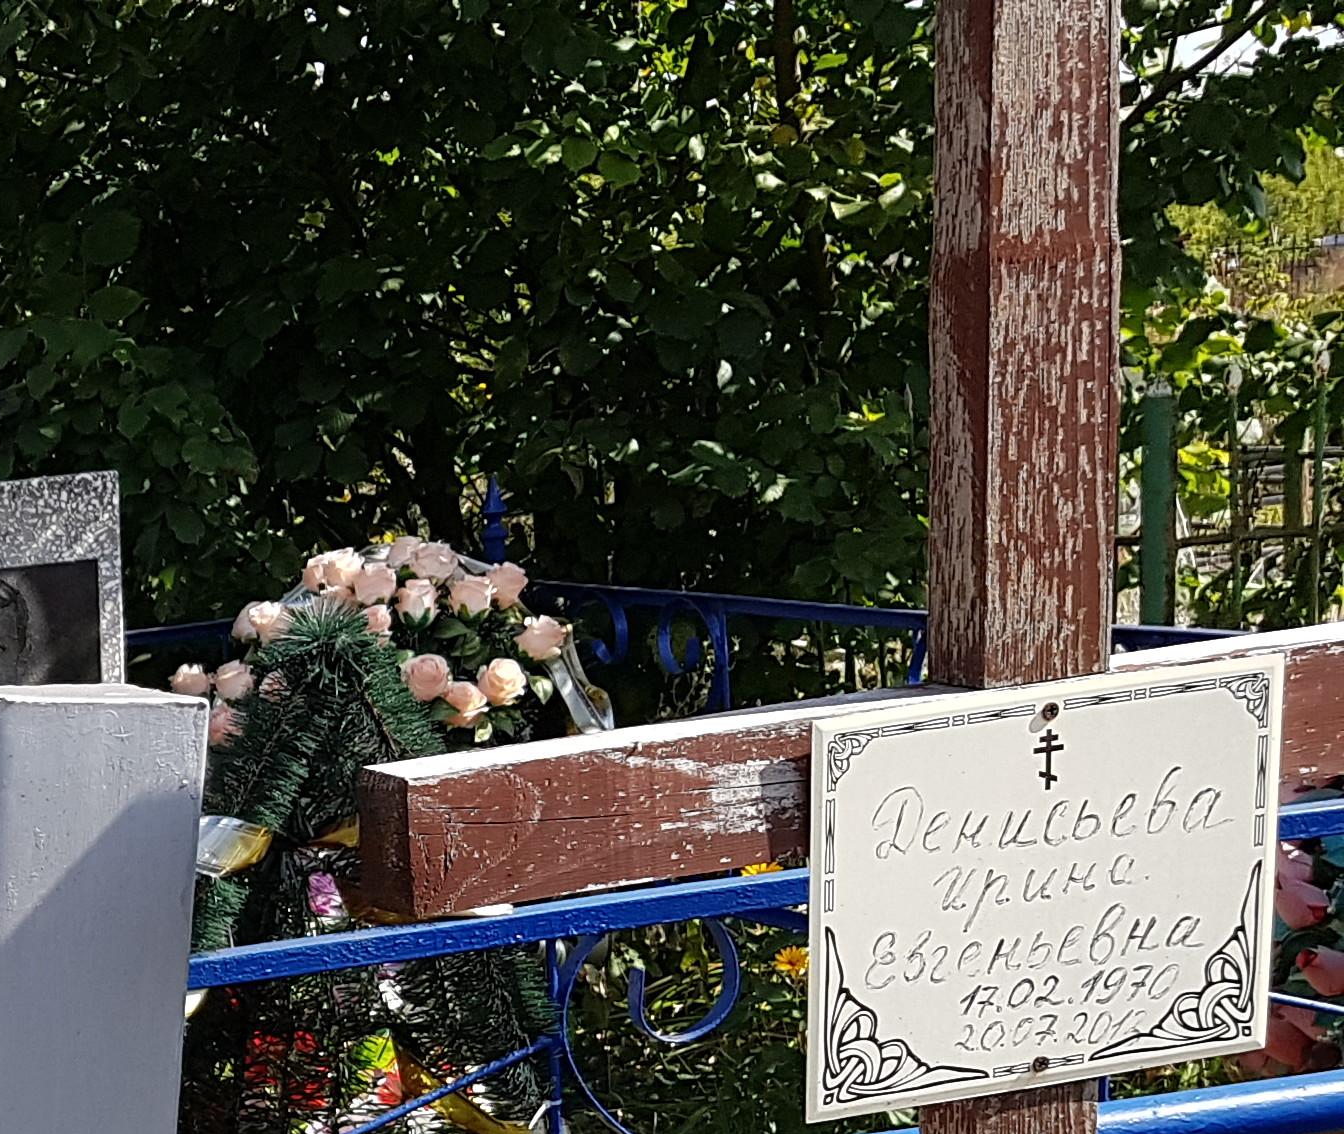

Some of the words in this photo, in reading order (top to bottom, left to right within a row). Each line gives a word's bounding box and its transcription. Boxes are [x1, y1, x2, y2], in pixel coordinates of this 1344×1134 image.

[871, 766, 1234, 860] Денисьева
[864, 901, 1205, 991] Евгеньевна
[959, 963, 1180, 1018] 17.02.1970
